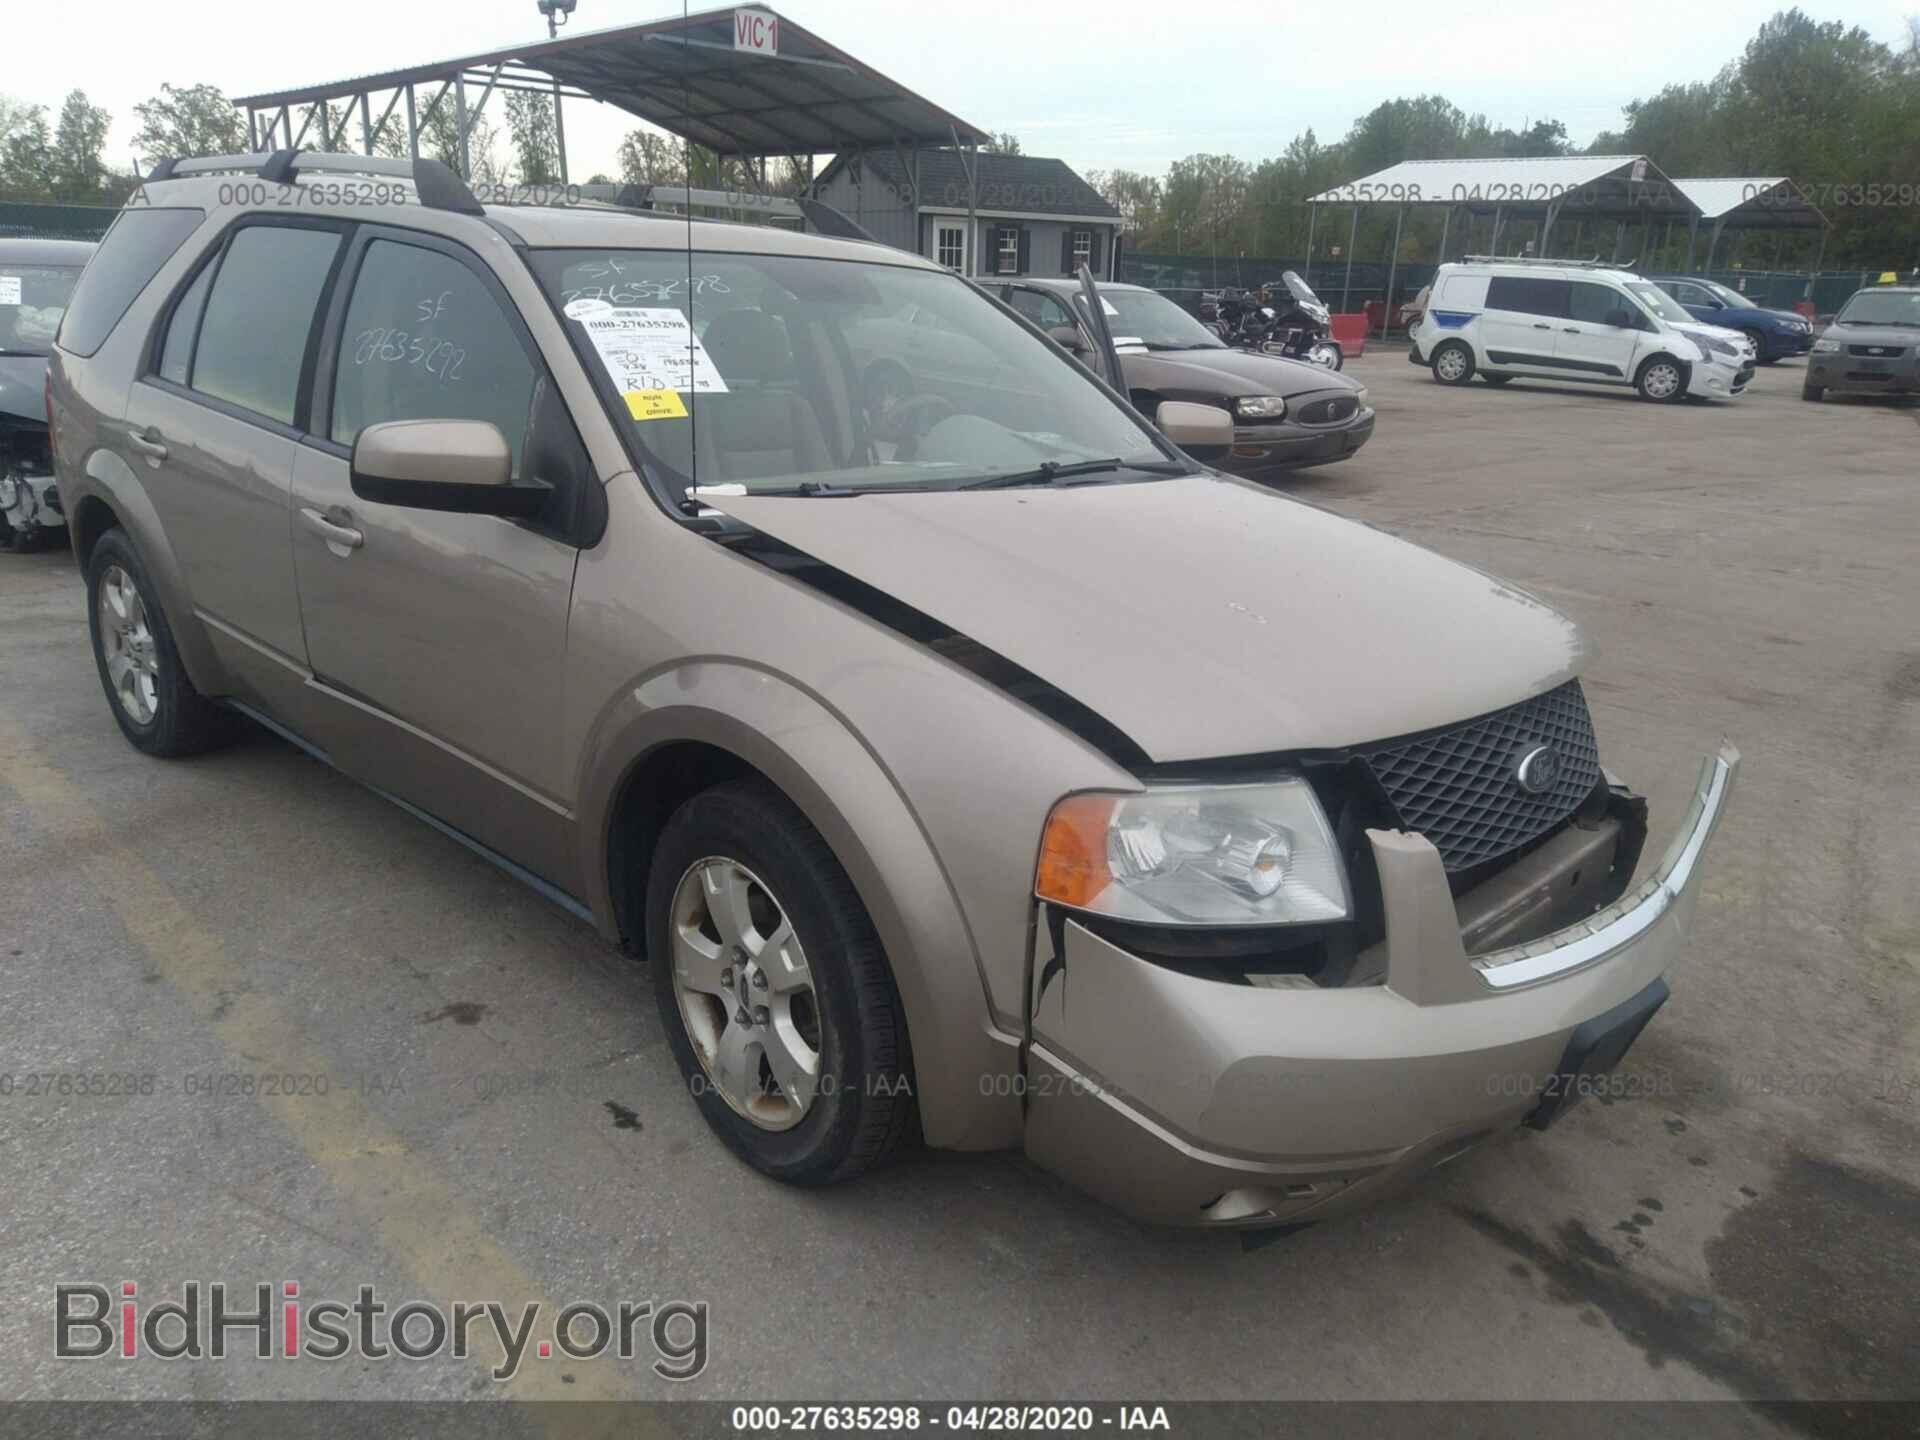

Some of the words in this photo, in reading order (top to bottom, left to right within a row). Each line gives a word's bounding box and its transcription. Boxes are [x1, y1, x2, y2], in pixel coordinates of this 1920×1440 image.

[736, 15, 764, 48] VIC
[768, 20, 777, 50] 1
[590, 320, 686, 328] 000-27635298
